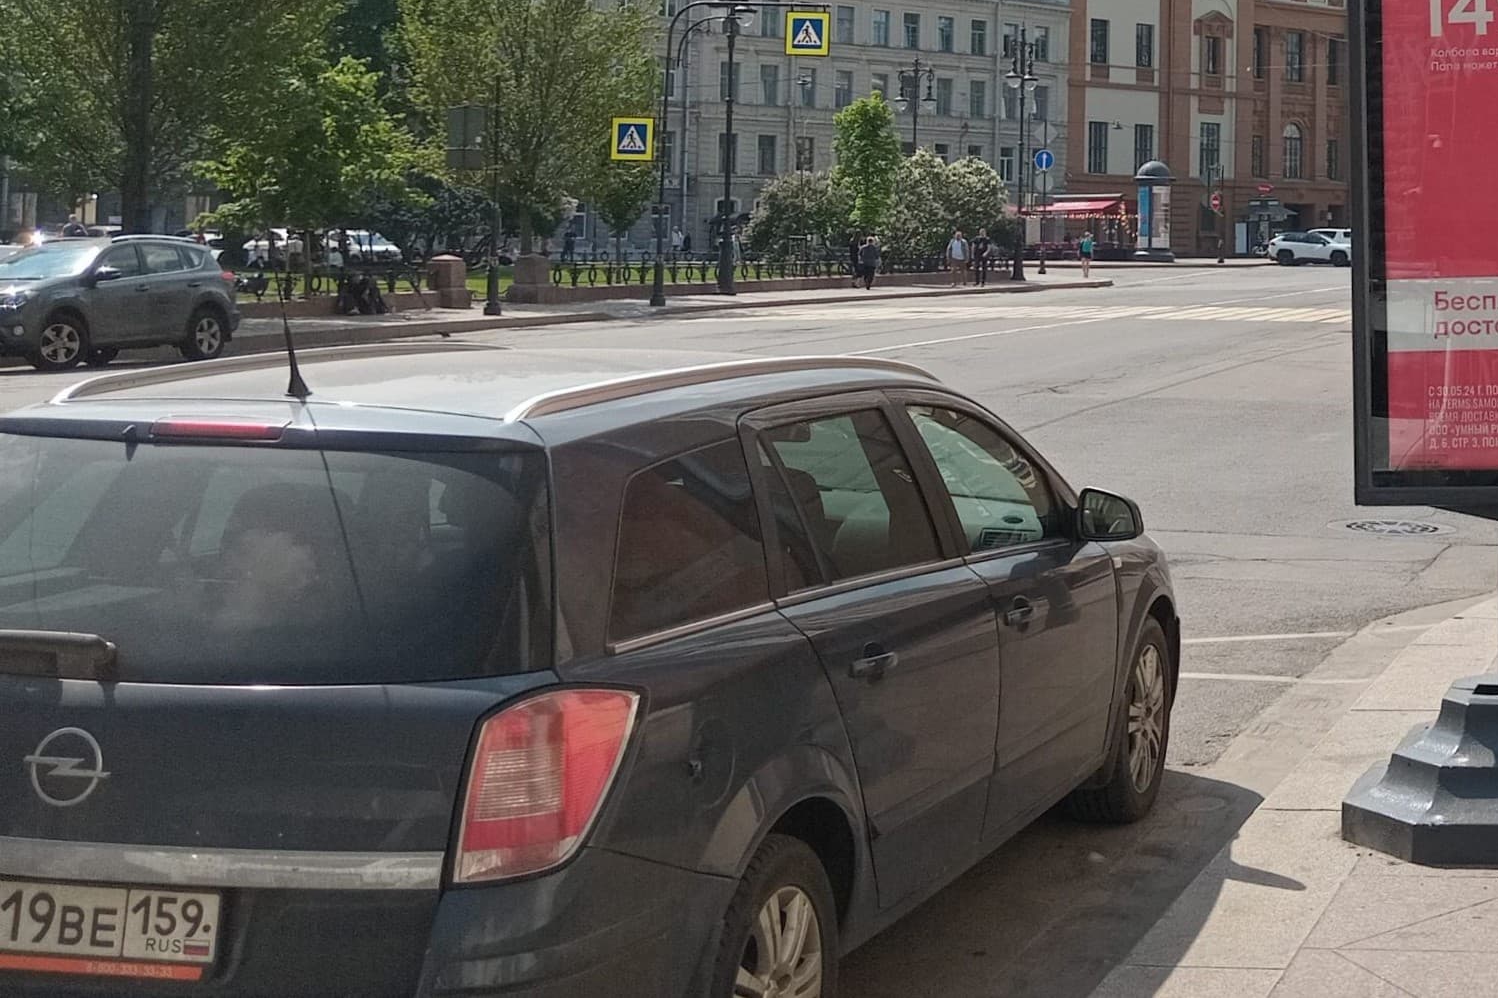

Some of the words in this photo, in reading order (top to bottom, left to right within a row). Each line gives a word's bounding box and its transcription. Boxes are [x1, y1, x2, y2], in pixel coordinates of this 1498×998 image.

[1486, 385, 1498, 396] ПО
[131, 895, 204, 938] 159
[145, 938, 182, 954] RUS
